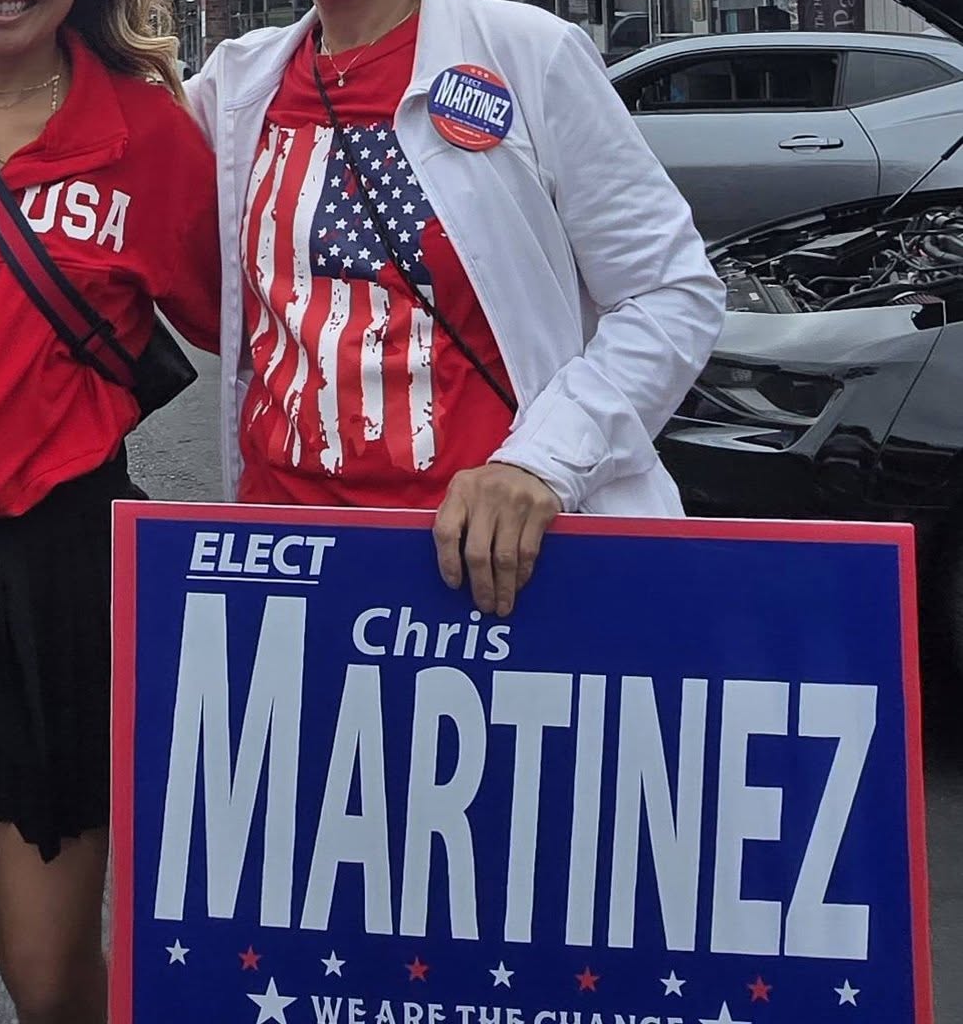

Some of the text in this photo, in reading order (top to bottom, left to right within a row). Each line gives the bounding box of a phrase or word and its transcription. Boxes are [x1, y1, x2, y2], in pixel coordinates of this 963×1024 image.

[434, 71, 511, 127] MARTINEZ
[20, 180, 131, 253] USA
[188, 532, 336, 576] ELECT
[352, 608, 511, 661] Chris
[154, 591, 878, 961] MARTINEZ
[310, 995, 366, 1024] WE
[375, 1000, 446, 1024] ARE
